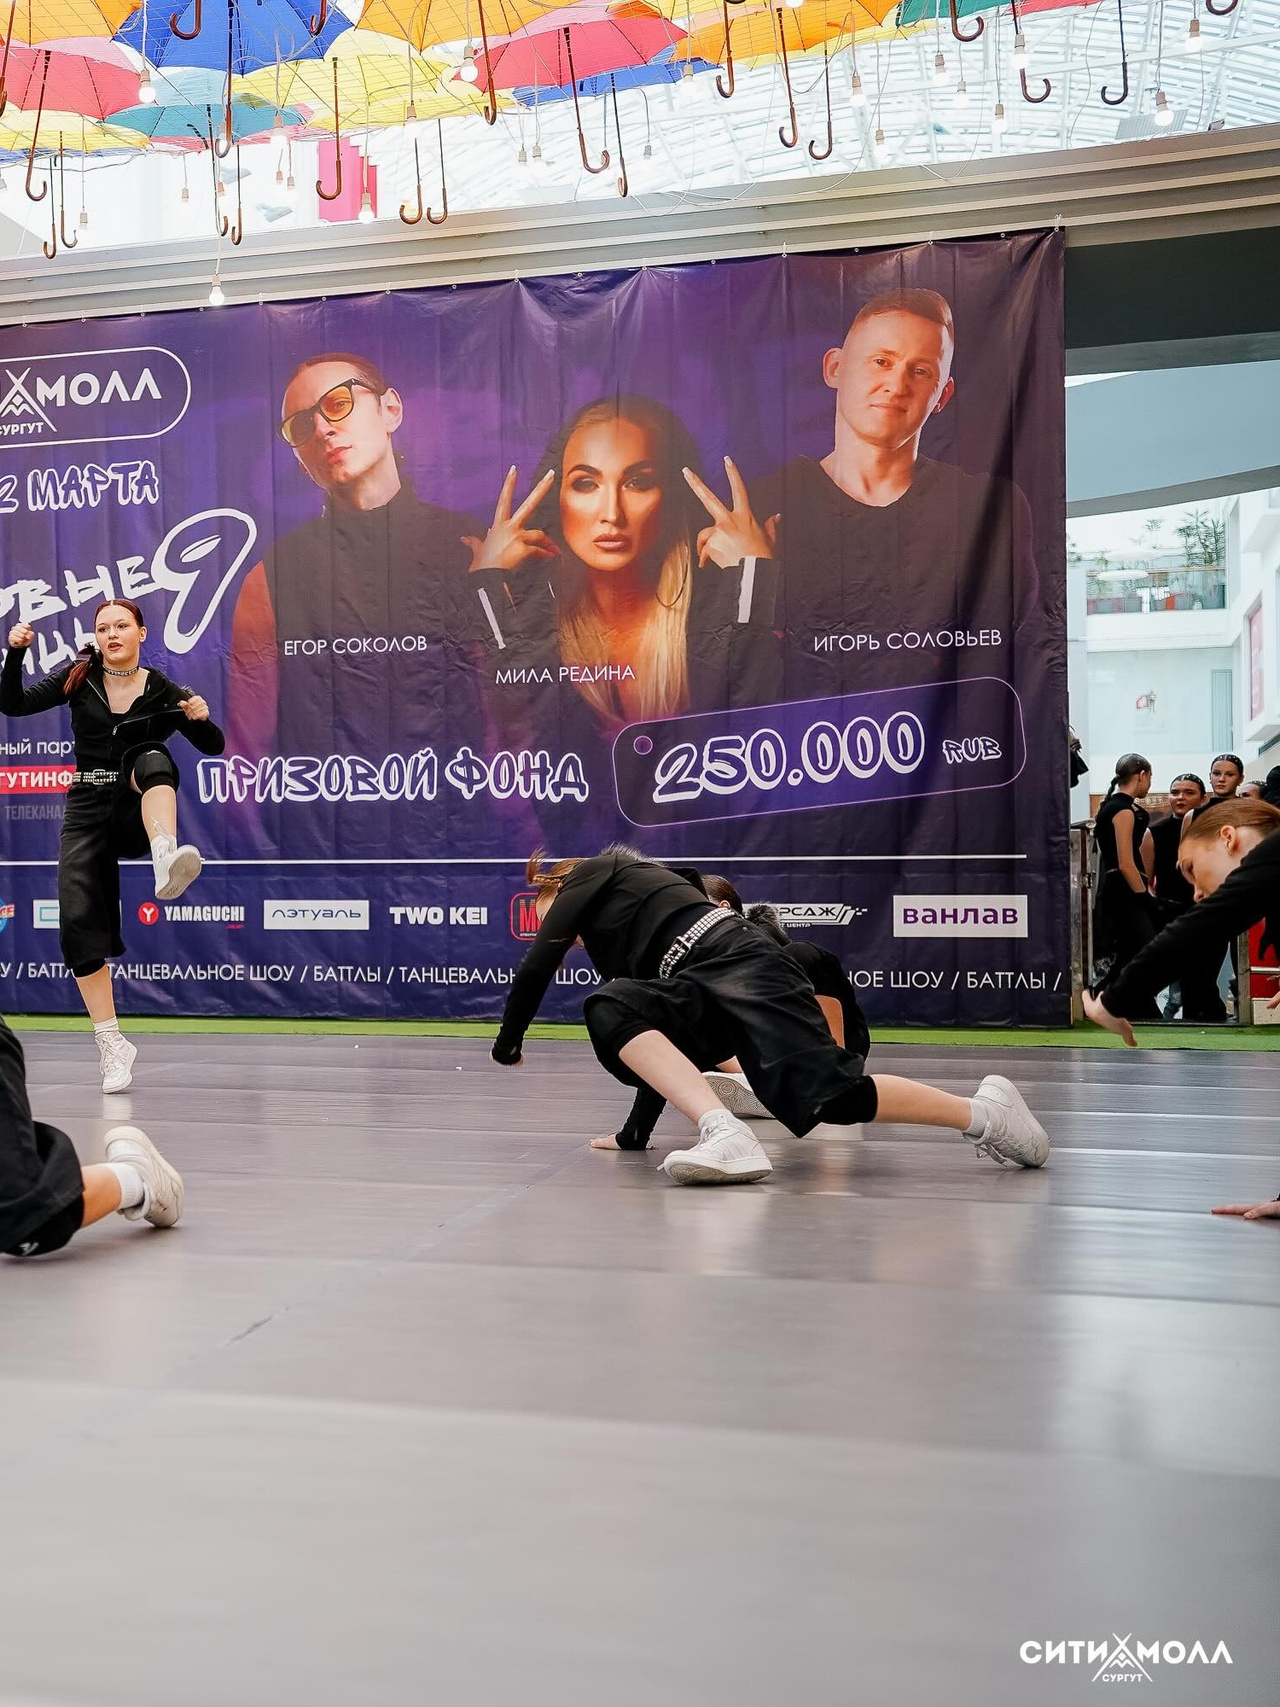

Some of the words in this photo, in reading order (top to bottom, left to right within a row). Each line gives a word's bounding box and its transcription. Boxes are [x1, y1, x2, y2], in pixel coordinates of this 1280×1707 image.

[35, 367, 162, 408] МОЛЛ
[26, 459, 160, 513] МАРТА
[283, 639, 326, 657] ЕГОР
[332, 635, 428, 655] СОКОЛОВ
[814, 634, 881, 652] ИГОРЬ
[886, 629, 1003, 651] СОЛОВЬЕВ
[495, 667, 554, 685] МИЛА
[558, 664, 636, 684] РЕДИНА
[36, 740, 75, 758] пар
[652, 710, 926, 804] 250.000
[942, 736, 1003, 765] RUB
[196, 746, 438, 804] ПРИЗОВОЙ
[444, 746, 590, 803] ФОНД
[164, 905, 246, 922] YAMAGUCHI
[389, 906, 445, 925] TWO
[449, 906, 489, 925] KEI
[779, 906, 837, 917] РСАЖ
[107, 963, 245, 982] ТАНЦЕВАЛЬНОЕ
[249, 964, 295, 983] ШОУ
[313, 965, 381, 983] БАТТЛЫ
[555, 968, 602, 985] ШОУ
[890, 971, 945, 988] ШОУ
[967, 971, 1047, 989] БАТТЛЫ
